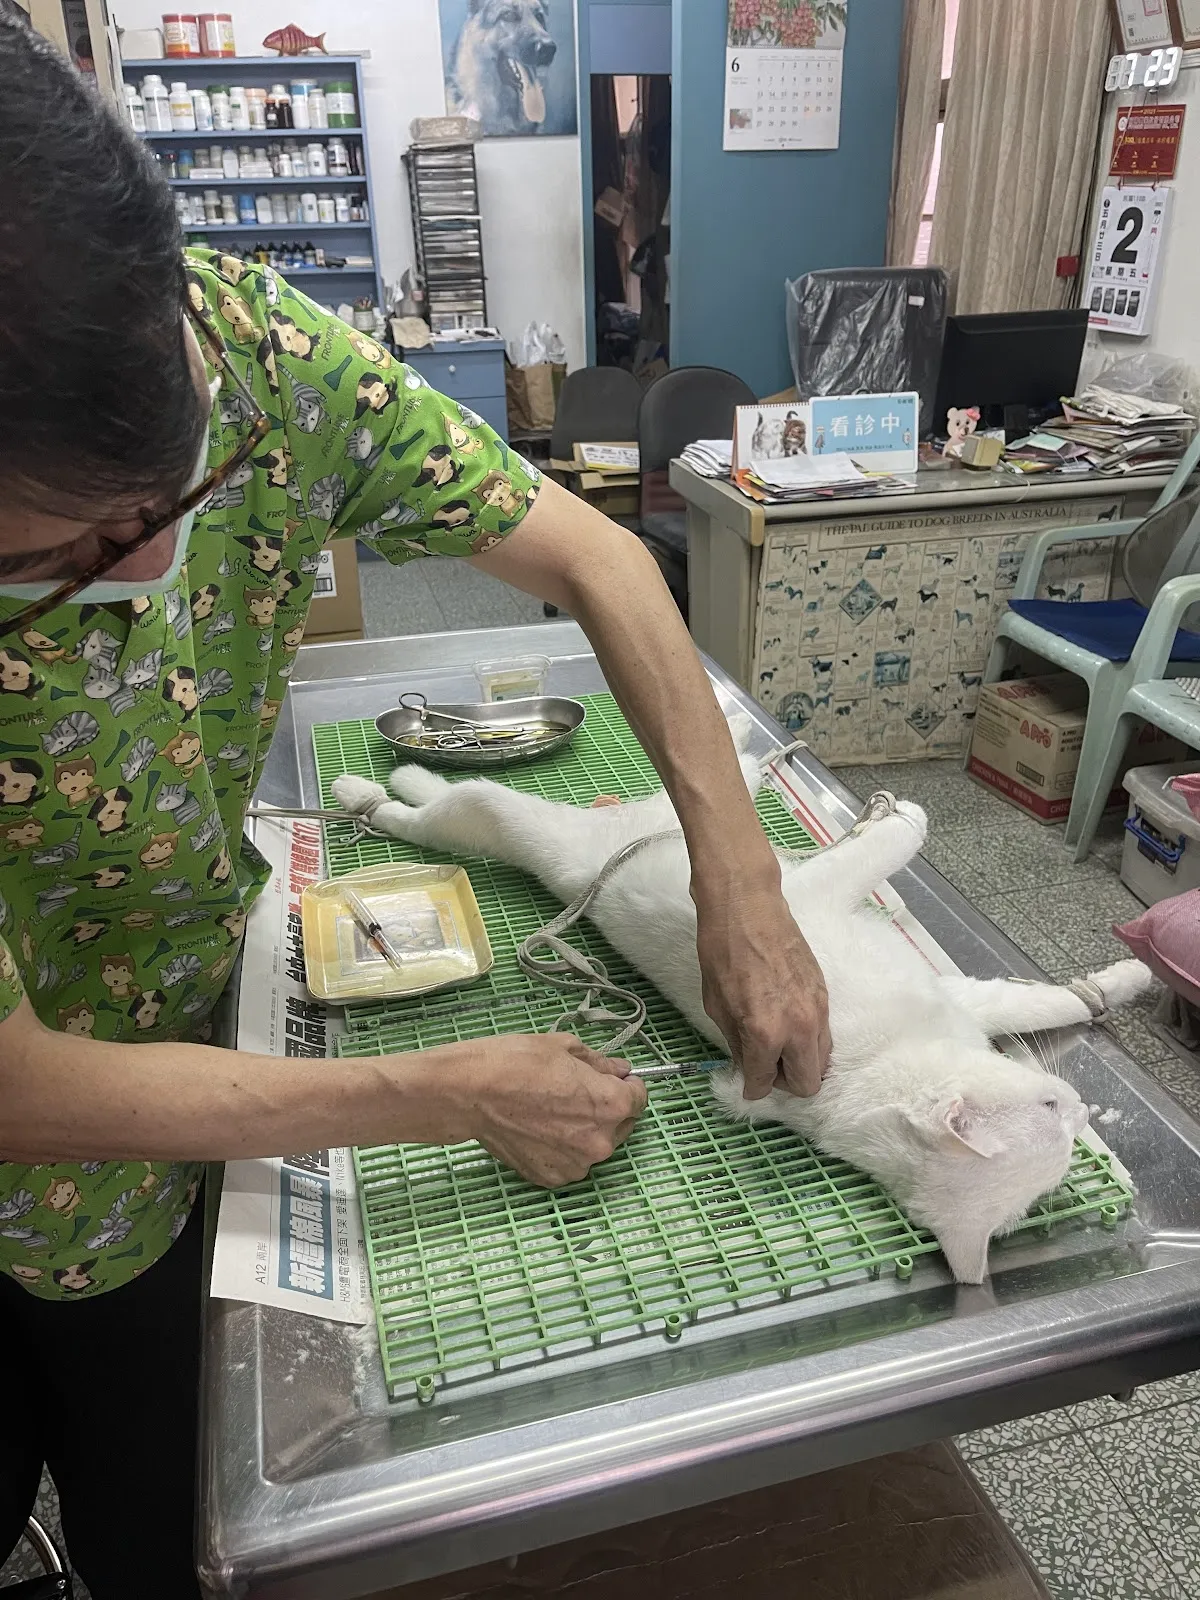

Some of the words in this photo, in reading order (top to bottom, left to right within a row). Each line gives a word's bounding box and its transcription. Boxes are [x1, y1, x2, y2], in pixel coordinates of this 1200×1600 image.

[731, 57, 740, 72] 6
[1144, 47, 1179, 87] 23
[1110, 206, 1144, 264] 2
[829, 412, 900, 438] 看診中
[825, 525, 848, 536] THE
[850, 523, 870, 534] PAL
[871, 520, 906, 531] GUIDE
[908, 518, 923, 528] TO
[924, 516, 951, 527] DOG
[952, 513, 993, 524] BREEDS
[994, 511, 1006, 521] IN
[1008, 507, 1067, 520] AUSTRALIA
[1019, 719, 1030, 738] A
[177, 931, 220, 952] FRONTLINE
[289, 1174, 326, 1294] 新疆棉風暴
[257, 1242, 267, 1261] 兩岸
[255, 1263, 267, 1285] A12
